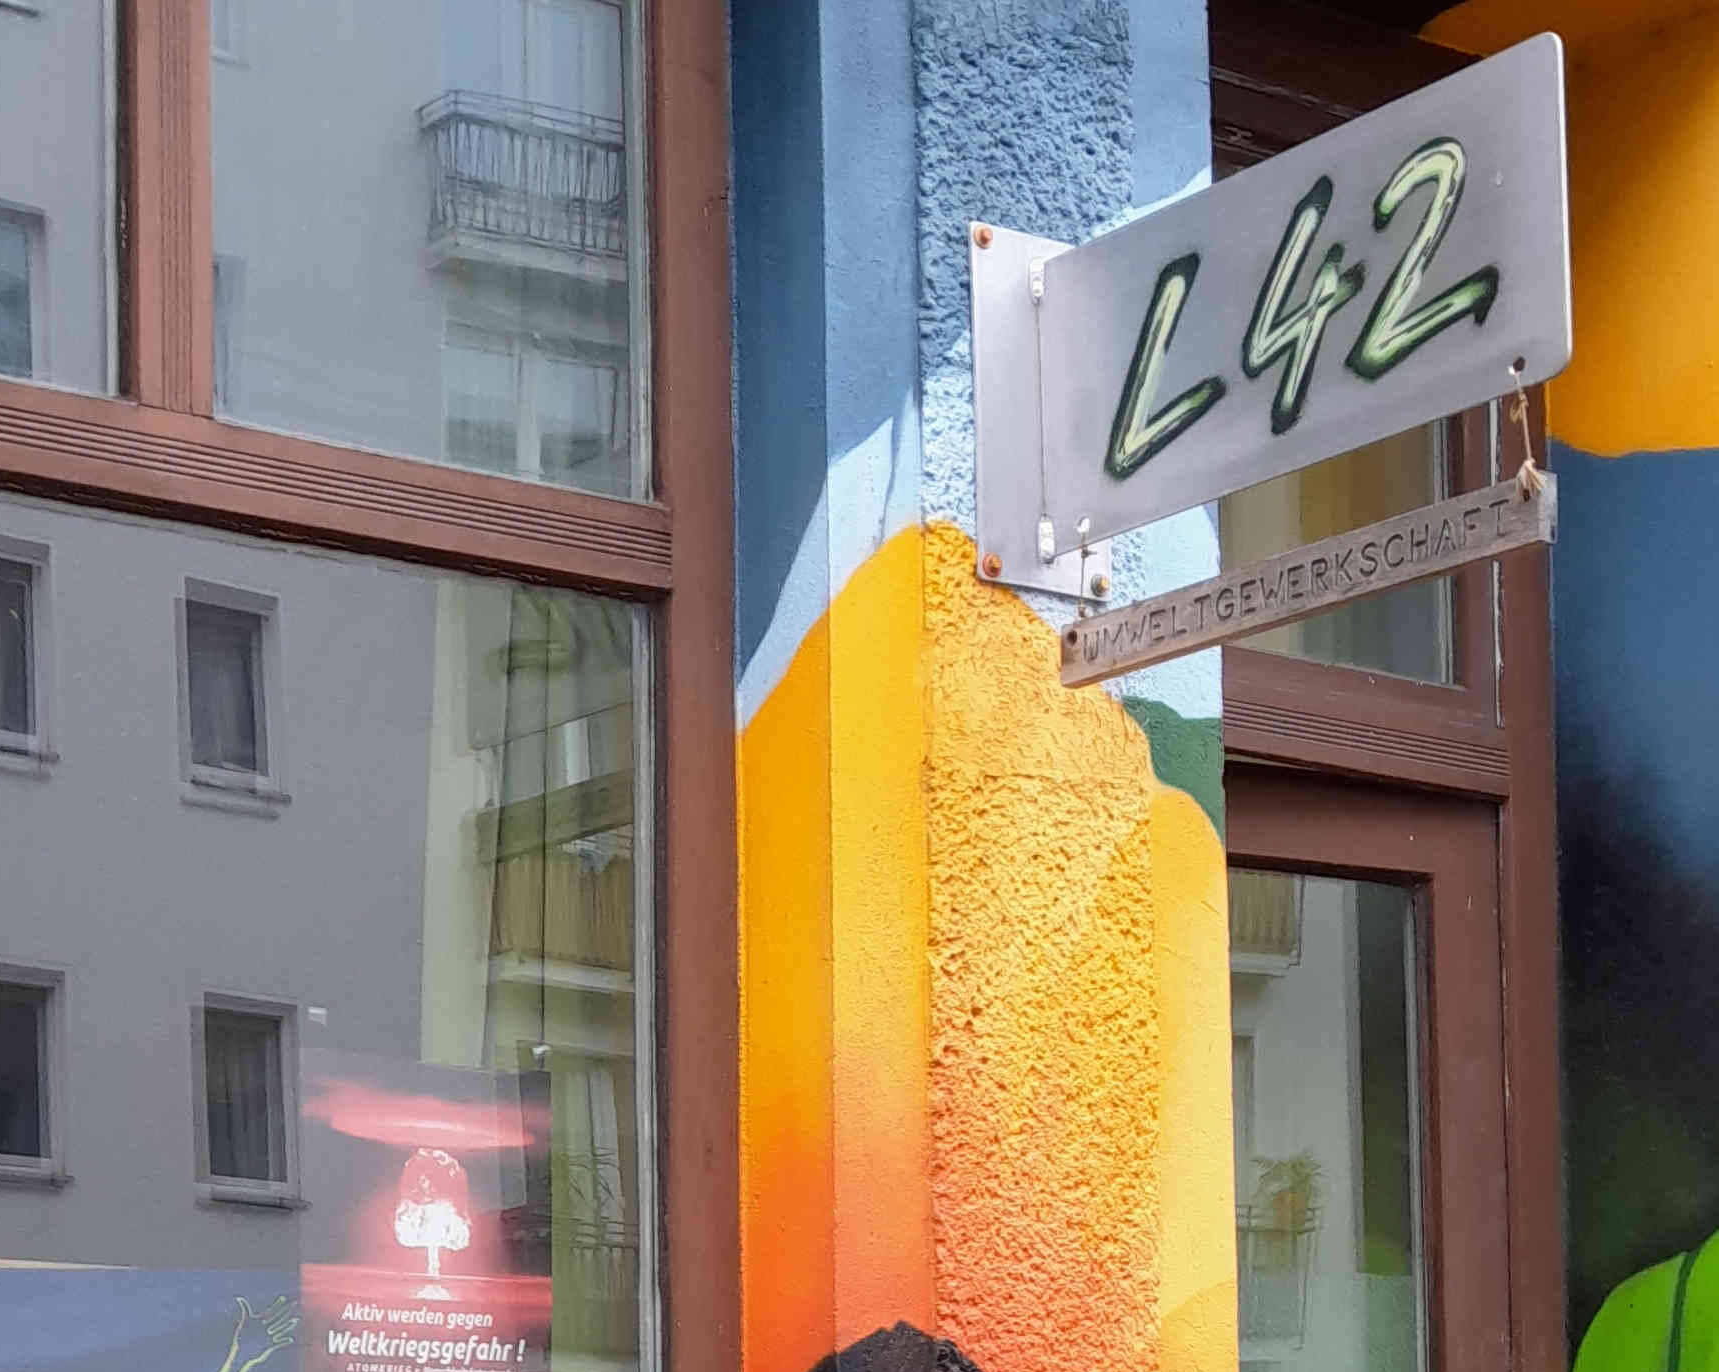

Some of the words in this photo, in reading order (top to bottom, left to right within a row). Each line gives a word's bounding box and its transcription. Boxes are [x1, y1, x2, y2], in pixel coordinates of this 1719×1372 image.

[1105, 137, 1499, 480] L42
[1083, 499, 1512, 663] UMWELTGEWERKSCHAFT
[328, 1330, 513, 1365] Weltkriegsgefahr
[342, 1303, 383, 1321] Aktiv
[388, 1306, 443, 1326] werden
[447, 1312, 493, 1330] gegen
